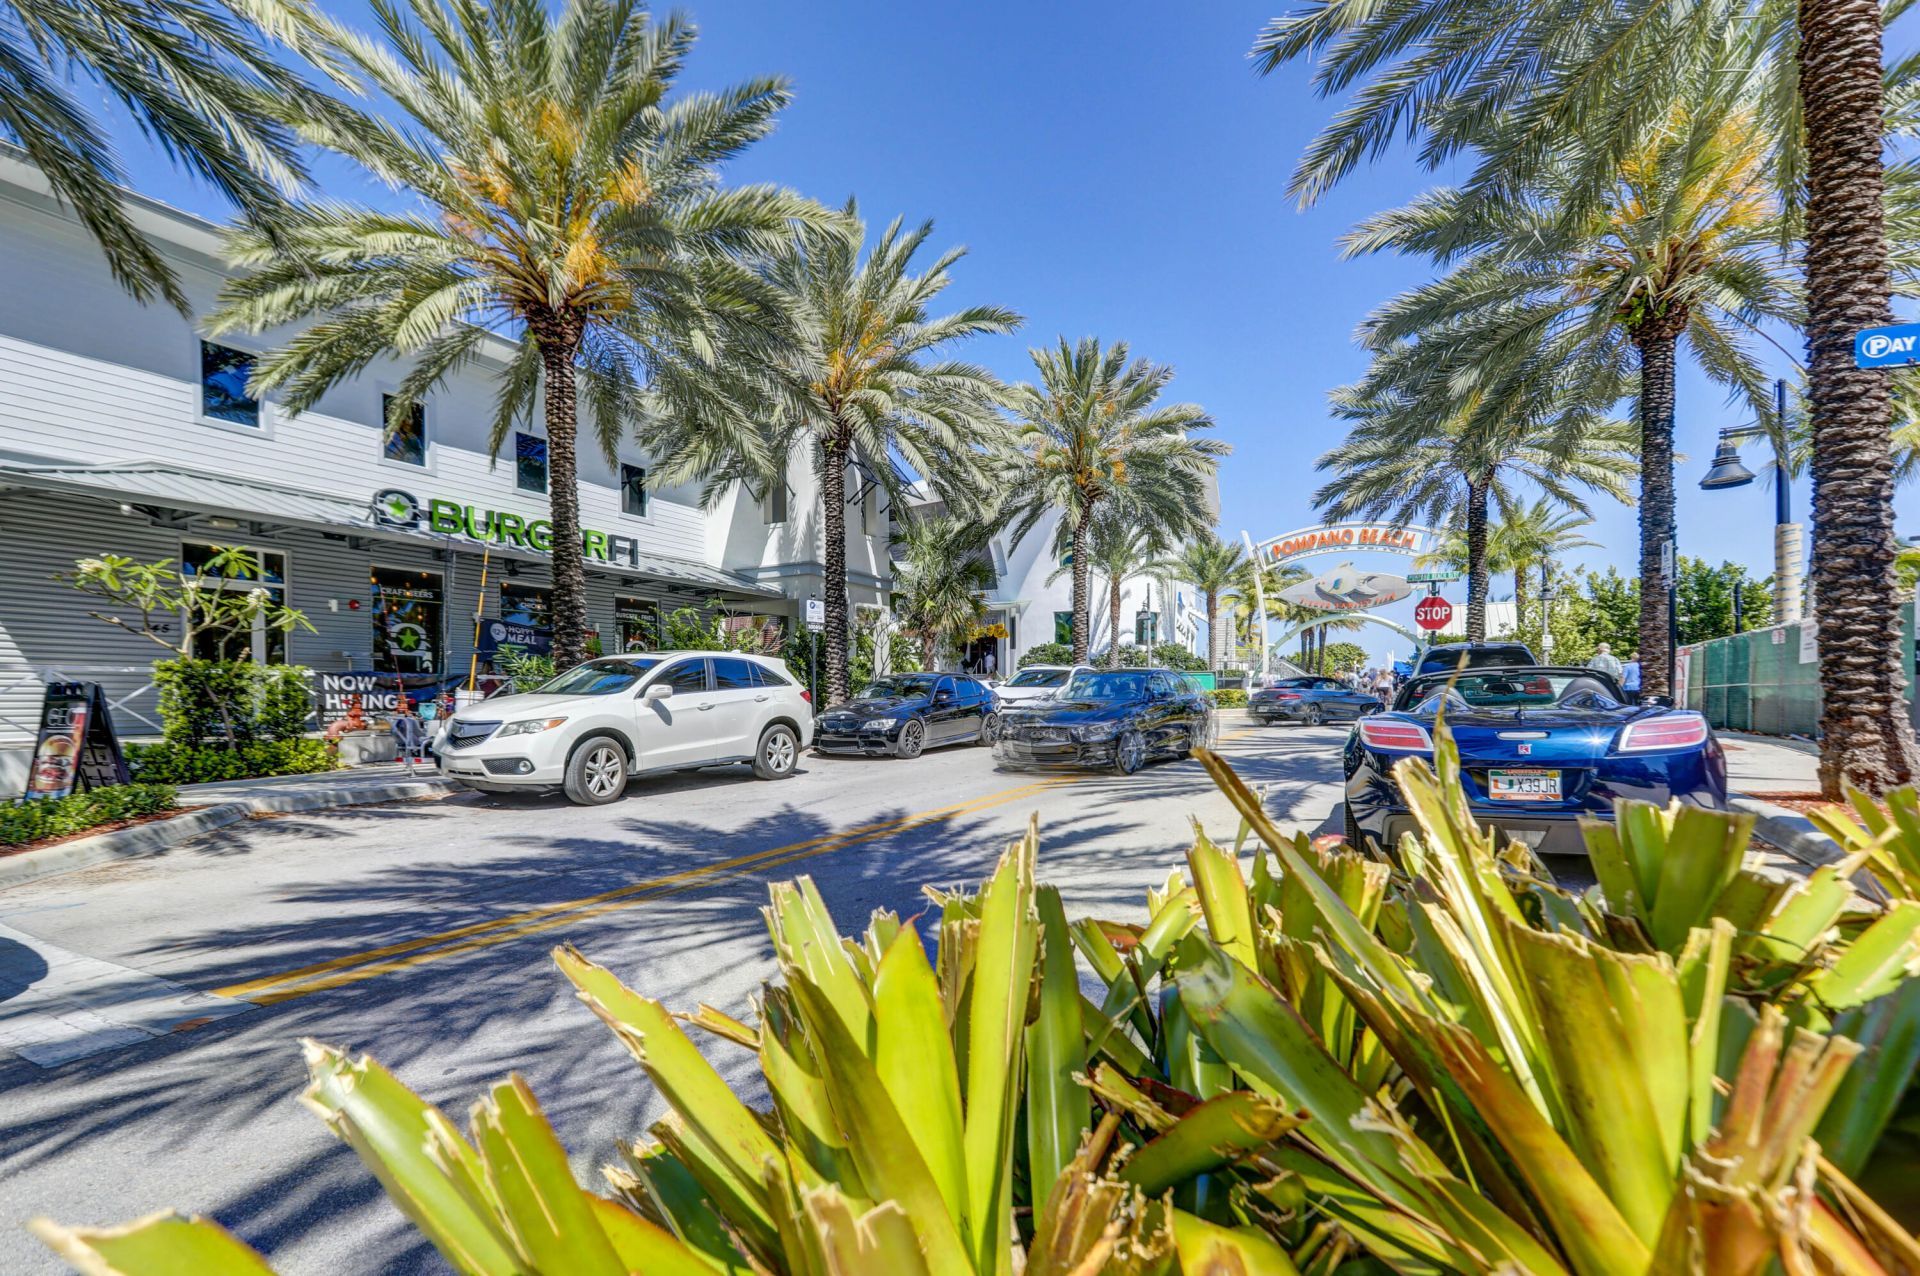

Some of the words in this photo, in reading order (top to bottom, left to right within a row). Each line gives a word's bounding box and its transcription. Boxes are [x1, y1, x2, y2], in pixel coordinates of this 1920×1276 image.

[1869, 336, 1918, 355] PAY
[428, 499, 639, 566] BURGRFI
[1271, 528, 1354, 559] POMPANO
[1359, 528, 1416, 550] BEACH
[1416, 606, 1450, 620] STOP
[507, 634, 537, 645] MEAL
[323, 674, 377, 691] NOW
[325, 693, 397, 710] HIING
[1517, 778, 1558, 793] X39JR
